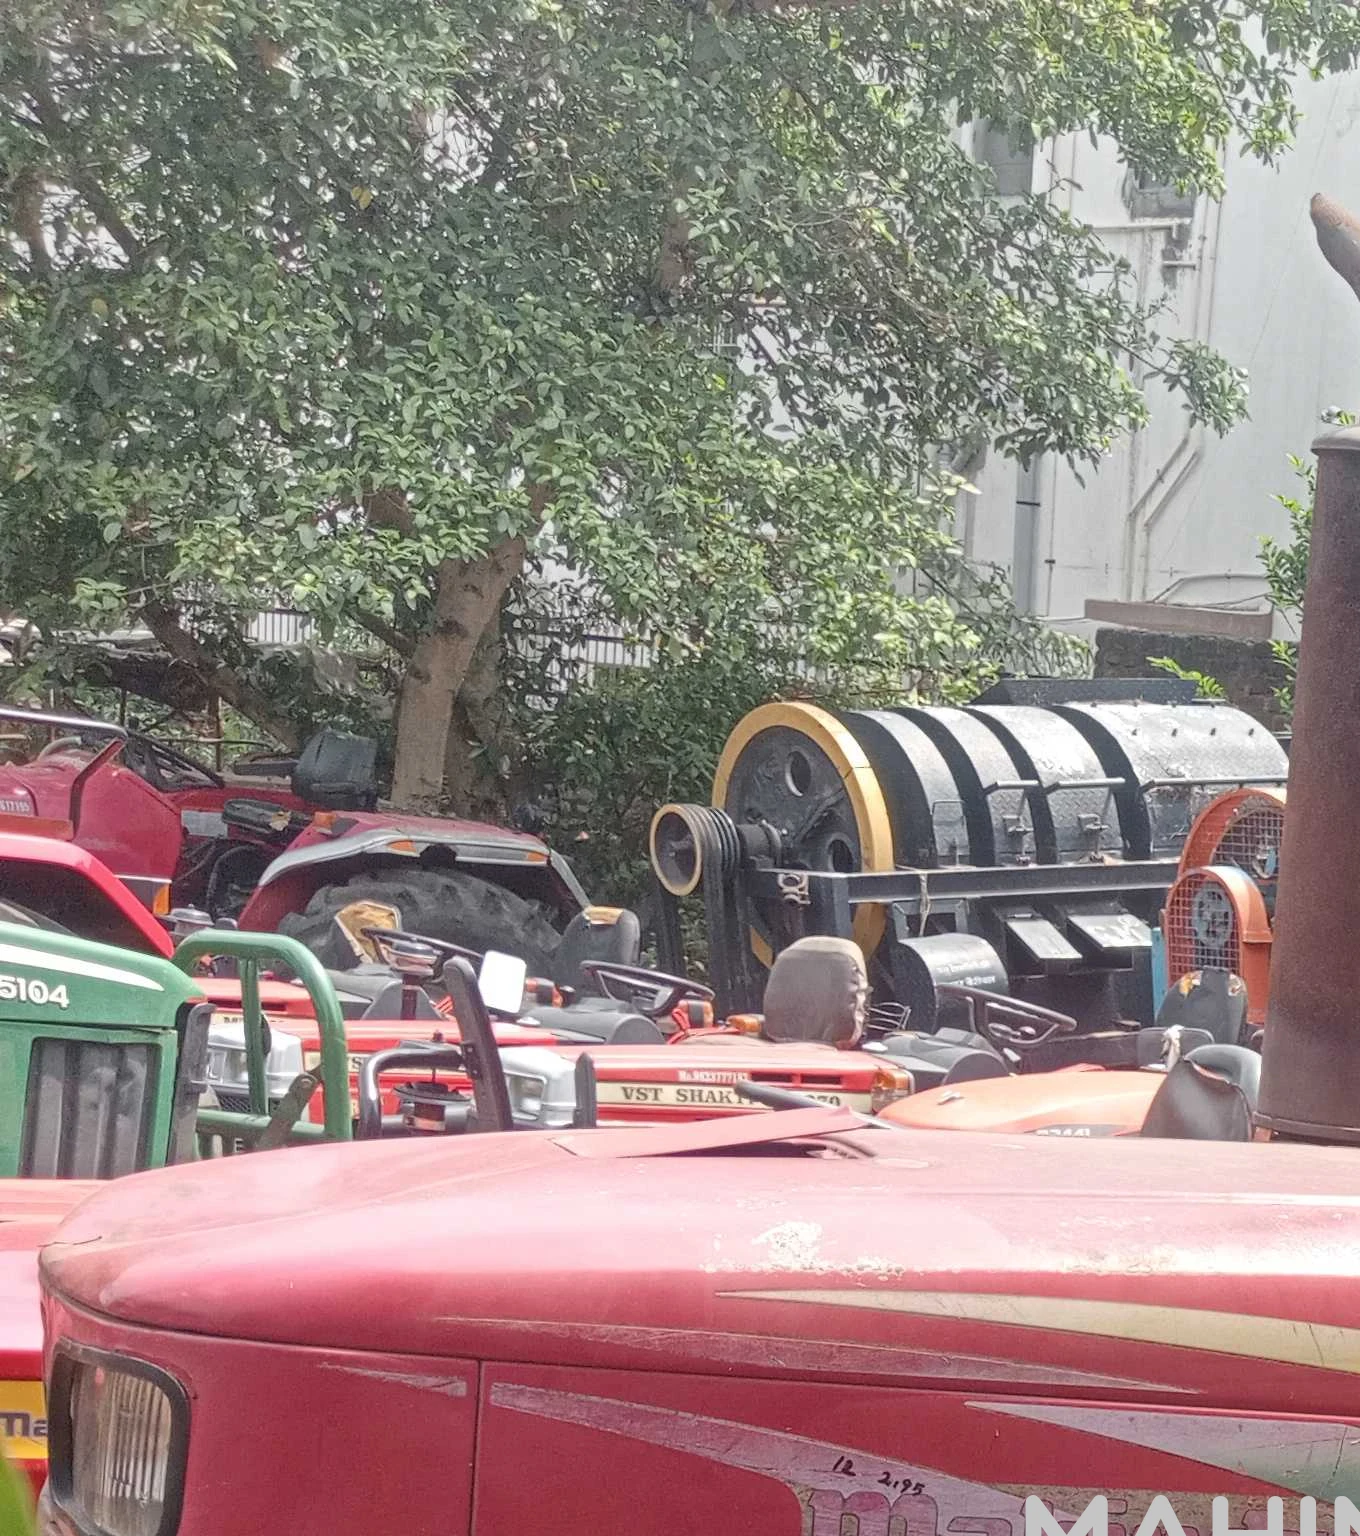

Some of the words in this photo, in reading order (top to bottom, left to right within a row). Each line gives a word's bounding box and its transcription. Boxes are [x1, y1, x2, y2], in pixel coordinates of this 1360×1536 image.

[0, 974, 70, 1009] 5104
[621, 1086, 663, 1101] VST
[832, 1455, 857, 1477] 12
